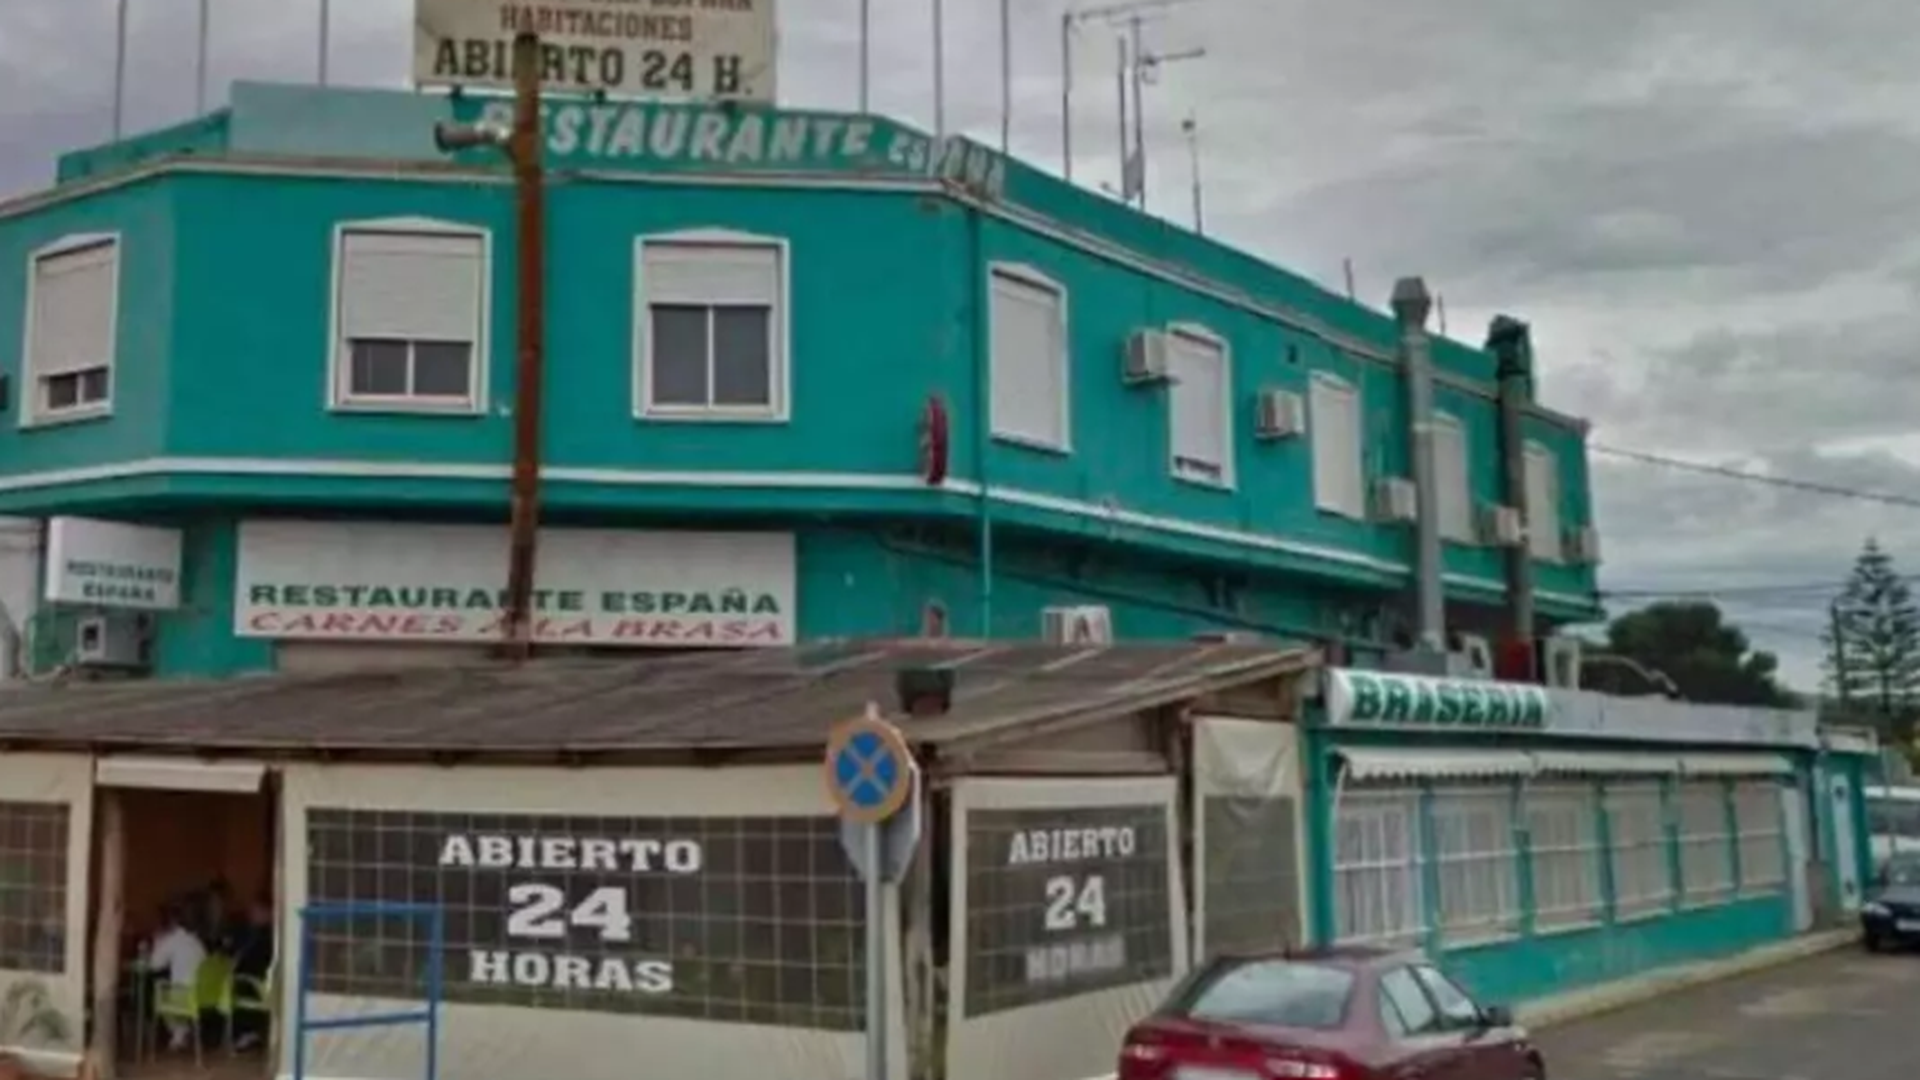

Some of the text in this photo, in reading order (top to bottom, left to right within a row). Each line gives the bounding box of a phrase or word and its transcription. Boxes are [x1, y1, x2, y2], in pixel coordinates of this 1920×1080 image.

[501, 5, 693, 41] HABITACIONES
[434, 38, 625, 87] ABIRTO
[642, 50, 694, 92] 24
[602, 587, 780, 614] ESPAÑA
[251, 612, 460, 634] CARNES
[536, 617, 592, 638] LA
[612, 619, 783, 640] BRASA
[1350, 674, 1545, 727] BRASERIA
[439, 835, 702, 873] ABIERTO
[1009, 827, 1137, 864] ABIERTO
[508, 883, 632, 941] 24
[1045, 875, 1106, 930] 24
[469, 950, 674, 992] HORAS
